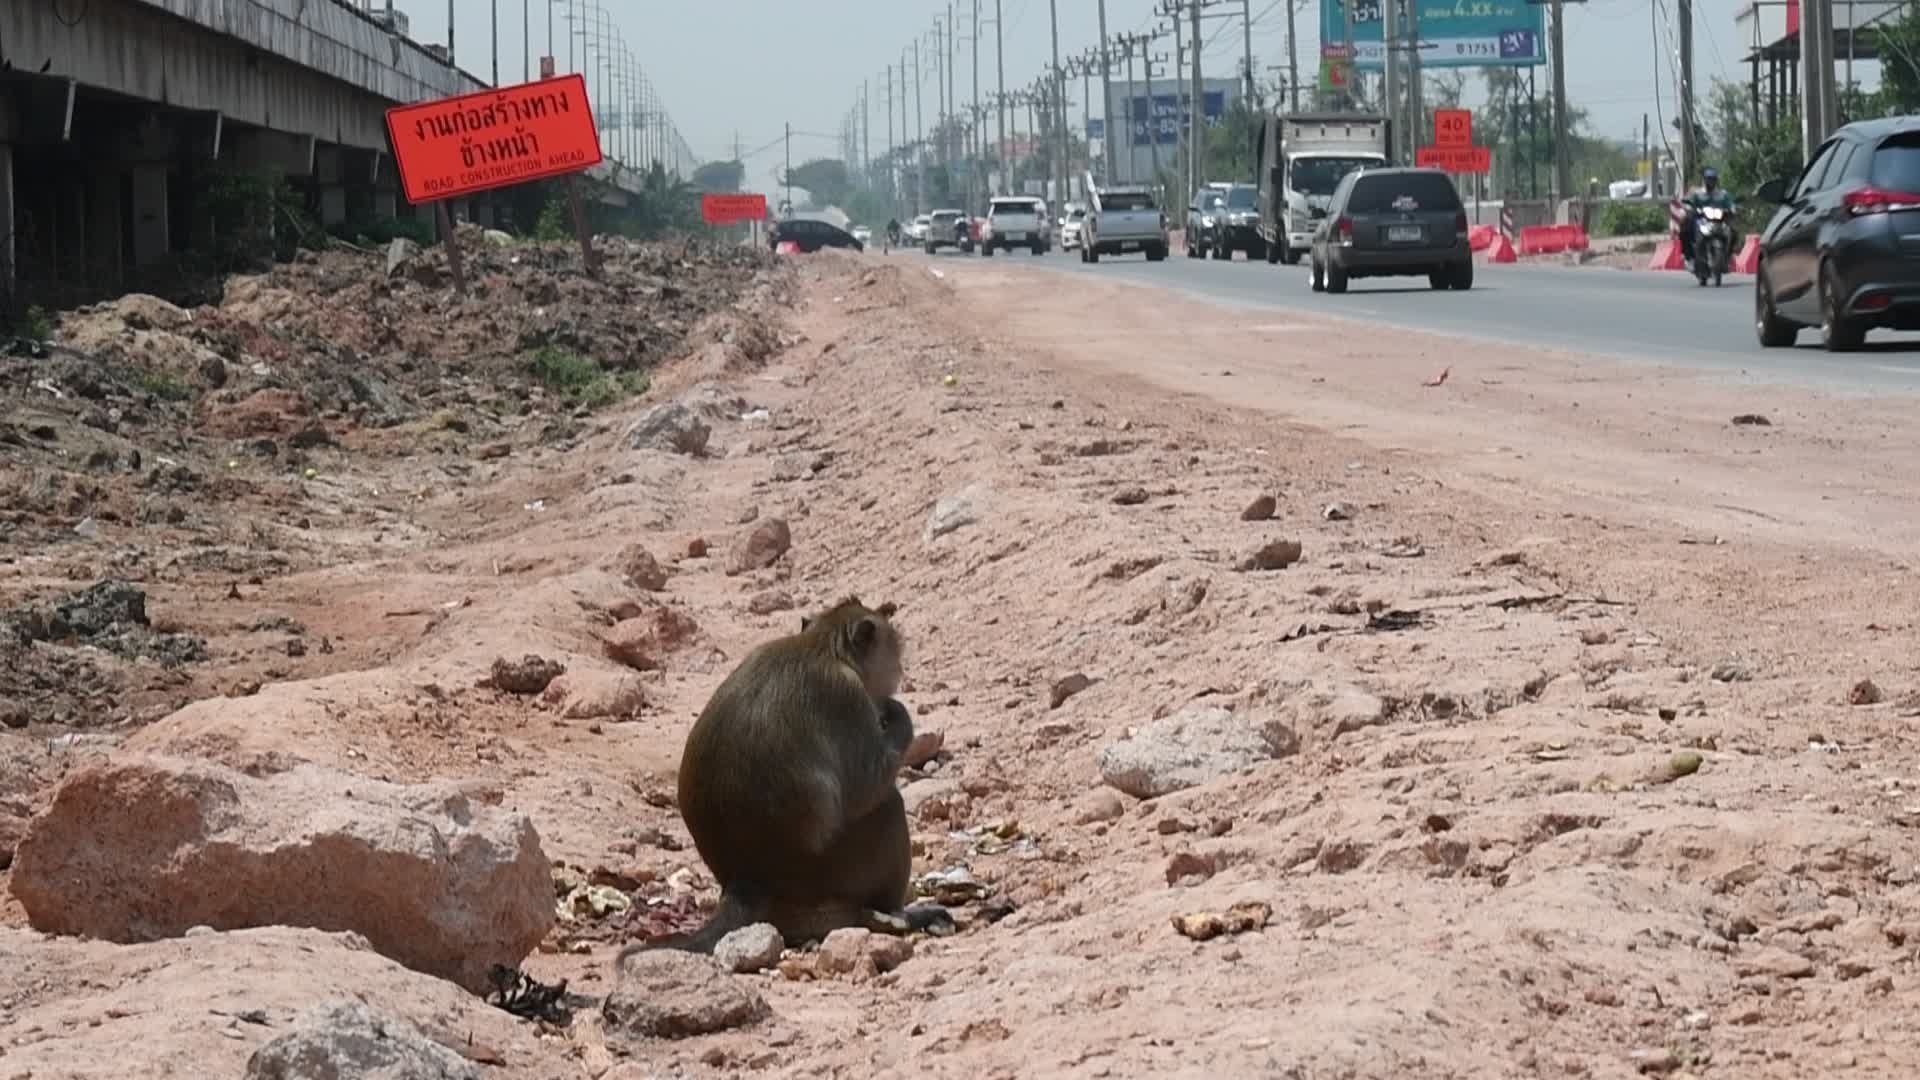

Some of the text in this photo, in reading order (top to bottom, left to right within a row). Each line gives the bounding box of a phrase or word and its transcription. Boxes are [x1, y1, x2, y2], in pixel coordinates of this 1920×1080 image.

[415, 91, 570, 141] งานก่อสร้างทาง
[460, 126, 540, 168] ข้างหน้า
[423, 150, 585, 192] ROAD CONSTRUCTION AHEAD
